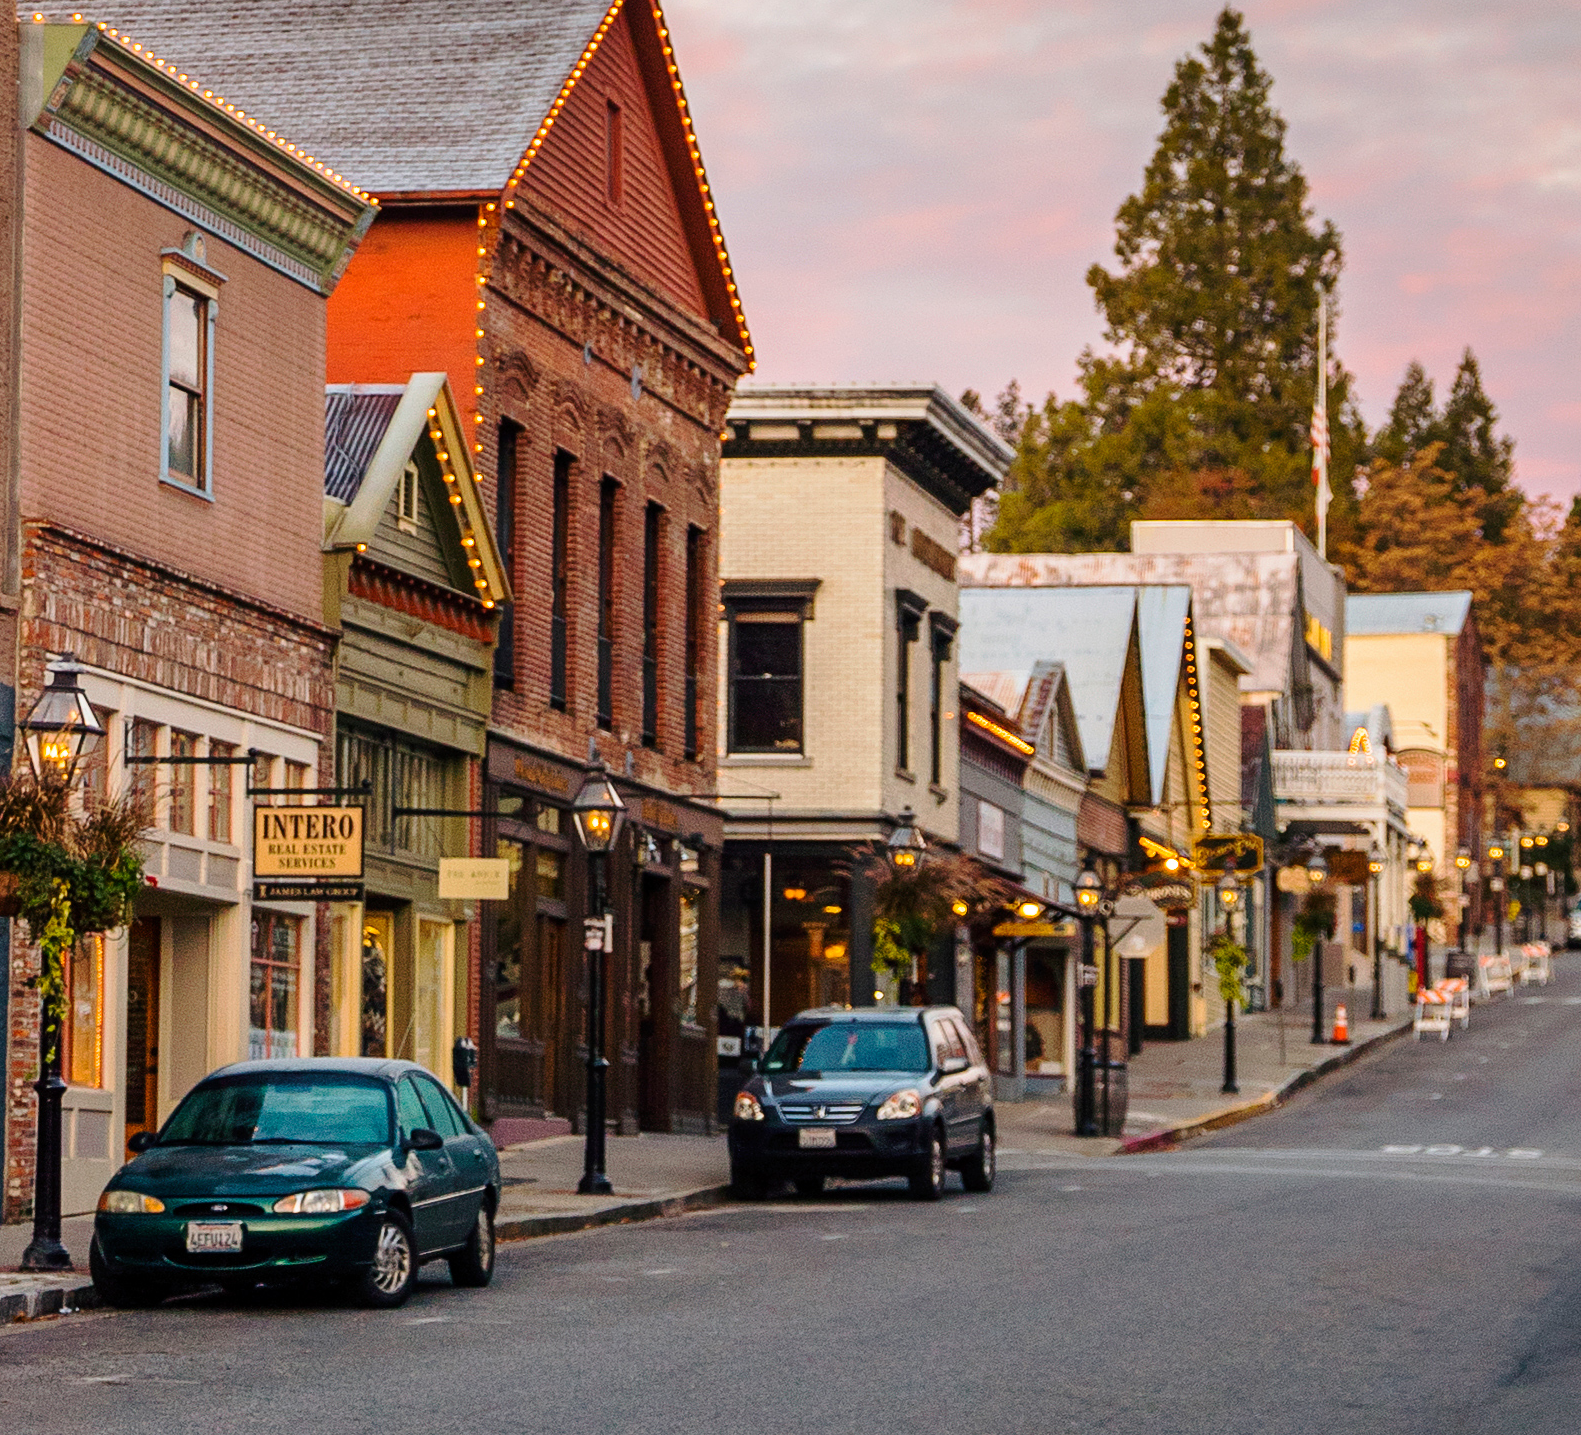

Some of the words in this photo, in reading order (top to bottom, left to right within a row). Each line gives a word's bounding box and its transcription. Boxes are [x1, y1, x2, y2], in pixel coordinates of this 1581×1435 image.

[263, 814, 354, 839] INTERO
[268, 844, 299, 855] REAL
[303, 844, 346, 855] ESTATE
[279, 858, 336, 869] SERVICES
